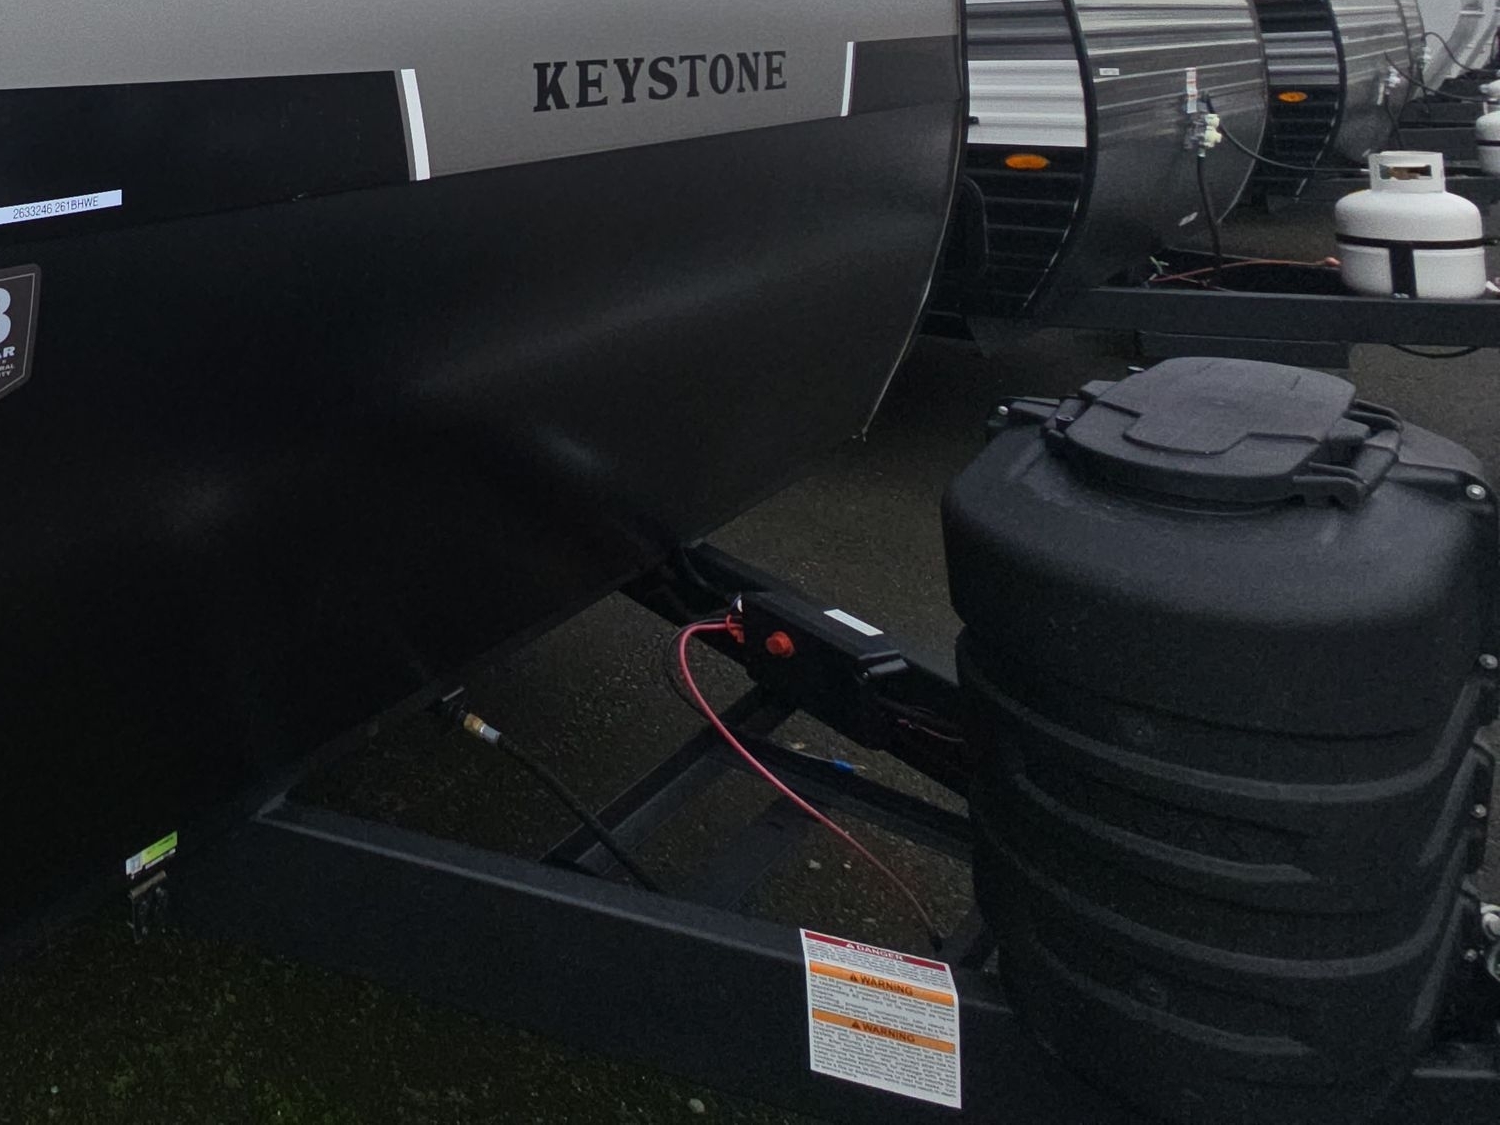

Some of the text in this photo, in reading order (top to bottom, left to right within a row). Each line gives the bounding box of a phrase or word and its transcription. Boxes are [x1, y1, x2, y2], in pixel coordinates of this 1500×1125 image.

[533, 50, 787, 113] KEYSTONE
[12, 196, 100, 220] 2633246 261BHWE
[856, 945, 904, 961] DANGER
[860, 975, 914, 997] WARNING
[861, 1023, 916, 1043] WARNING
